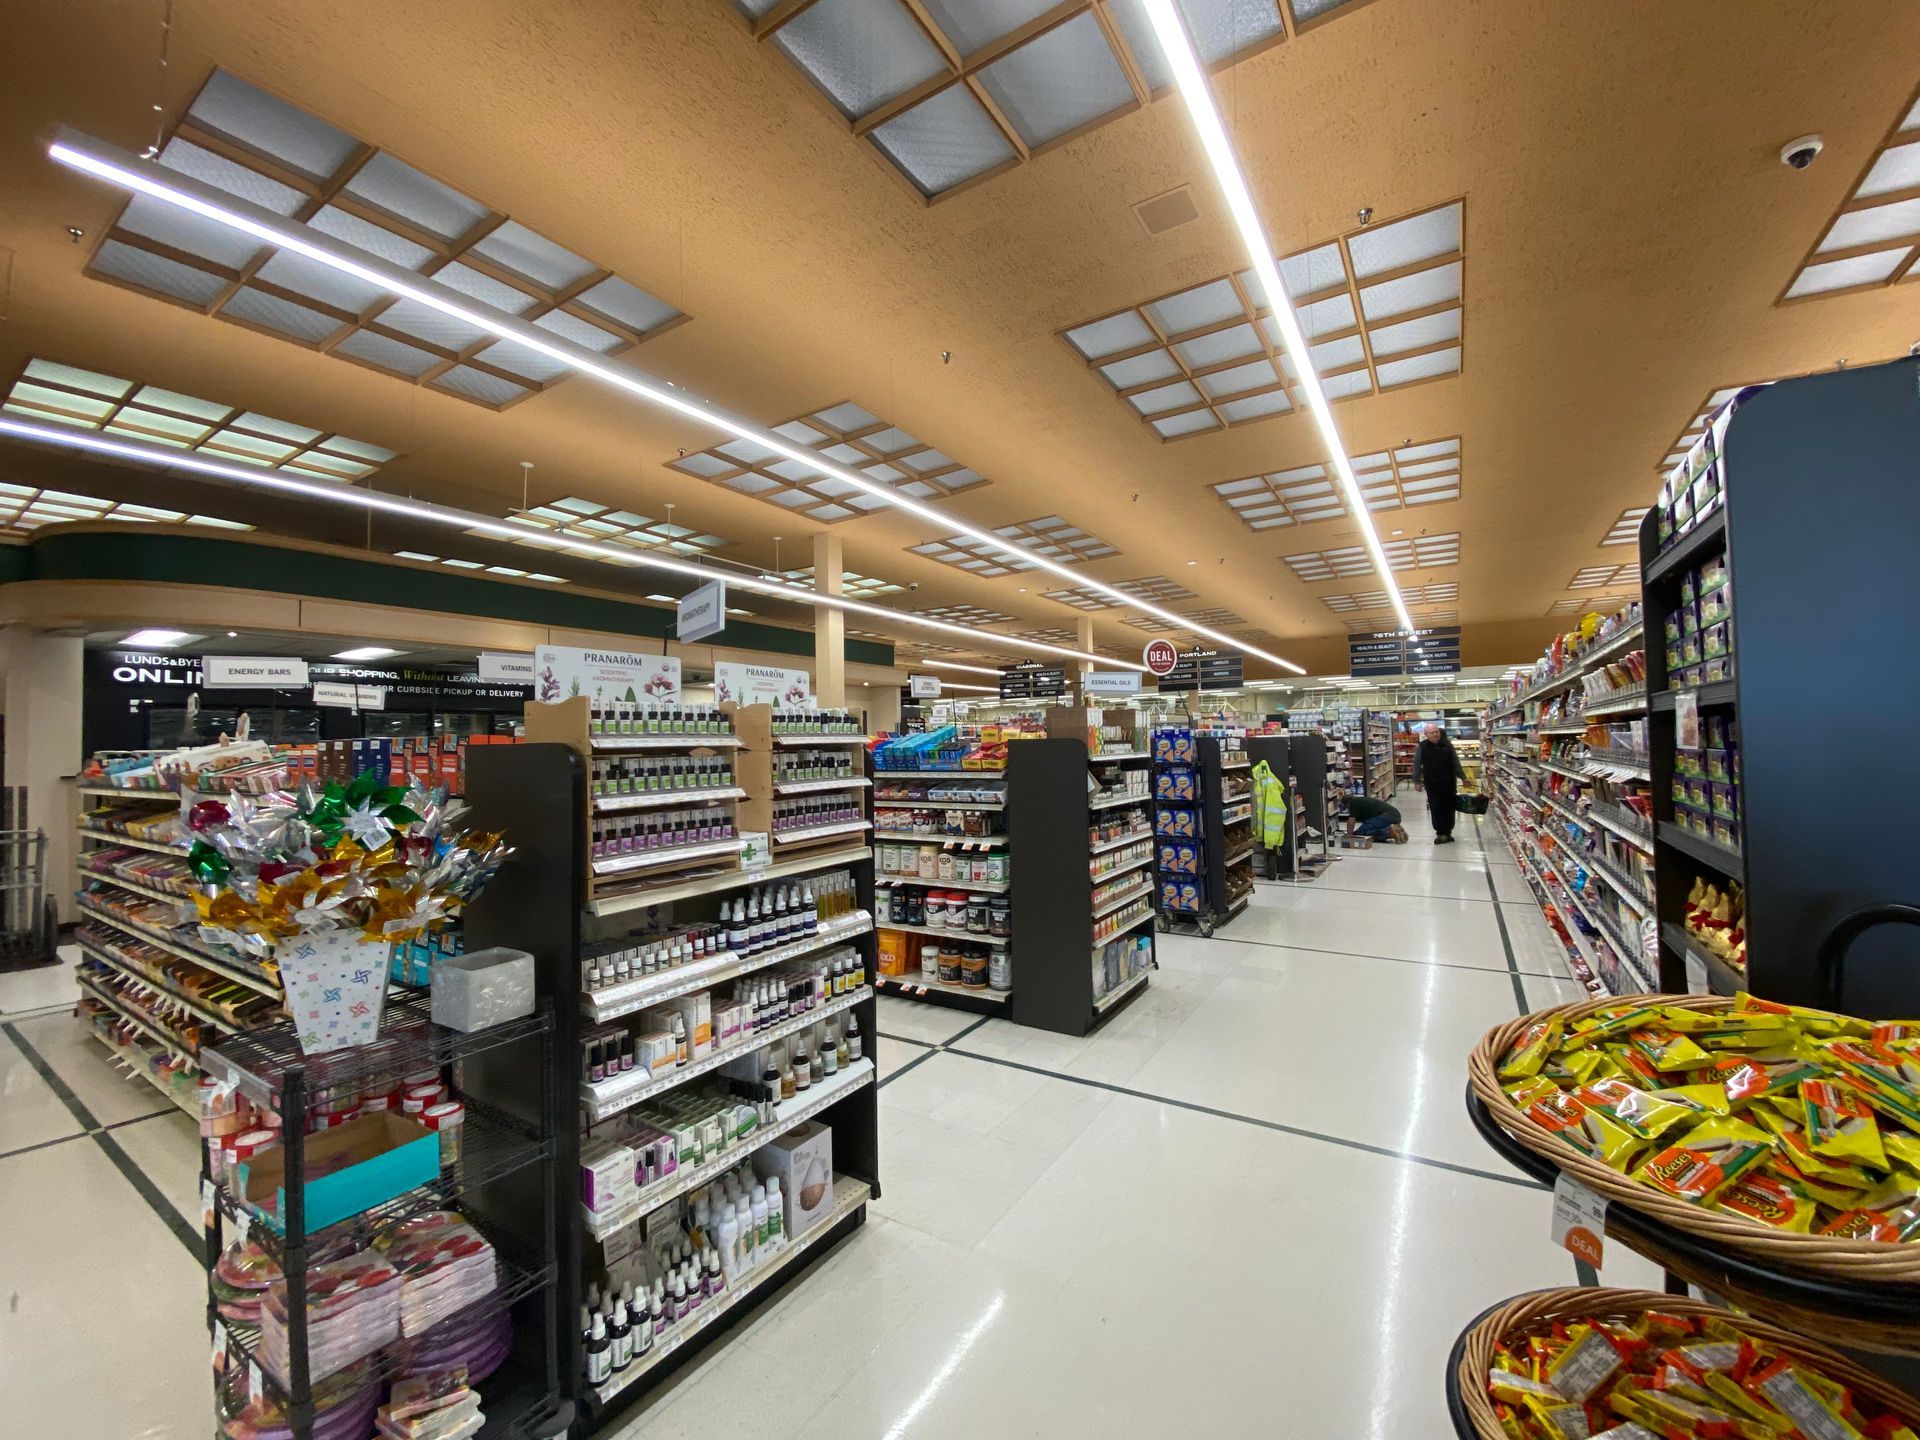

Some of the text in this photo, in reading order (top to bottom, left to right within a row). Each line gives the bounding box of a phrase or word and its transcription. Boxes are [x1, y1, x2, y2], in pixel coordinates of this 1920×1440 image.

[1398, 628, 1434, 637] STREET
[1149, 650, 1173, 662] DEAL
[1179, 650, 1218, 658] PORTLAND
[228, 668, 292, 676] ENERGY BARS
[500, 664, 533, 673] VITAMINS
[318, 690, 348, 699] NATURAL
[397, 685, 440, 695] CURBSIDE
[443, 687, 473, 696] PICKUP
[475, 688, 486, 696] OR
[489, 689, 524, 698] DELIVERY
[1571, 1234, 1600, 1261] DEAL
